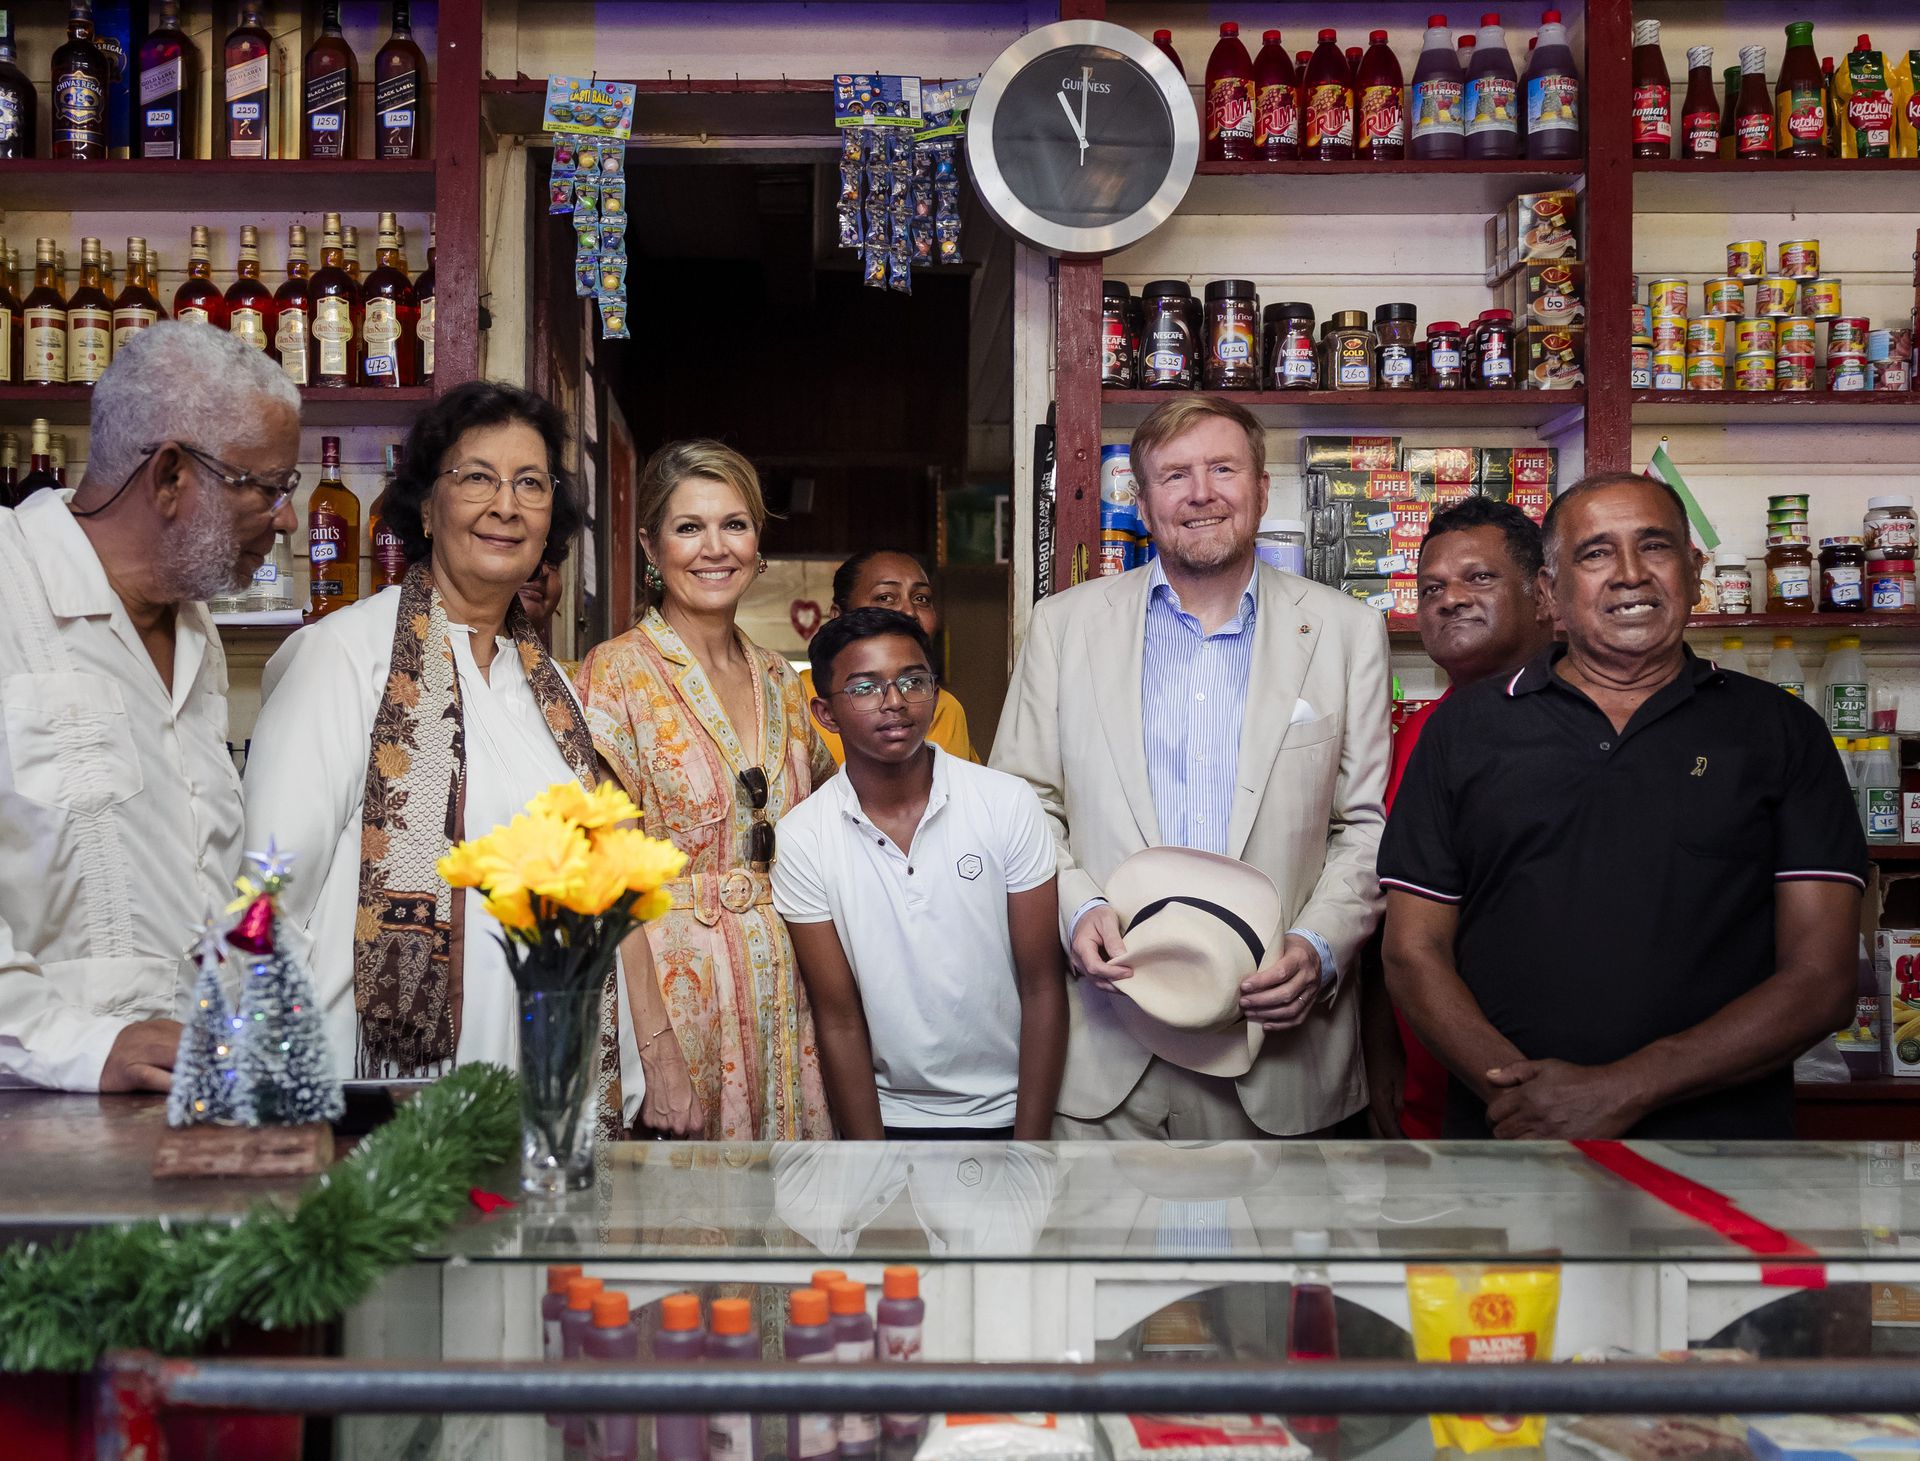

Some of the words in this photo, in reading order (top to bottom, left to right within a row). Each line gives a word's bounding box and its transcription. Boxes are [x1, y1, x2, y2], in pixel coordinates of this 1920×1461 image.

[141, 74, 160, 87] GOLD
[56, 80, 80, 92] CHIVAS
[81, 80, 102, 96] REGAL
[307, 86, 325, 98] BLACK
[326, 80, 345, 91] LABEL
[377, 89, 395, 100] BLACK
[395, 82, 414, 93] LABEL
[72, 92, 85, 102] 18
[236, 106, 257, 114] 2250
[1207, 97, 1252, 129] PRIMA
[1632, 106, 1668, 117] tomato
[150, 112, 170, 121] 2250
[316, 117, 337, 126] 1250
[389, 113, 408, 122] 1250
[1255, 105, 1298, 135] PRIMA
[1306, 105, 1350, 136] PRIMA
[1359, 105, 1404, 137] PRIMA
[1689, 131, 1719, 139] tomato
[1738, 124, 1769, 135] tomato
[1871, 131, 1884, 141] 65
[1696, 139, 1712, 148] 65
[1546, 296, 1562, 308] 60
[368, 359, 388, 371] 475
[1159, 357, 1180, 367] 325
[1344, 369, 1365, 379] 260
[1888, 372, 1901, 382] 45
[1516, 459, 1545, 468] THEE
[1374, 480, 1407, 491] THEE
[1515, 495, 1544, 504] THEE
[1393, 511, 1427, 522] THEE
[309, 526, 340, 540] rant's
[314, 545, 333, 557] 650
[1394, 548, 1420, 560] THE
[1392, 588, 1418, 599] THE
[1787, 583, 1803, 595] 75
[1839, 588, 1852, 598] 75
[1834, 701, 1865, 710] AZIJN
